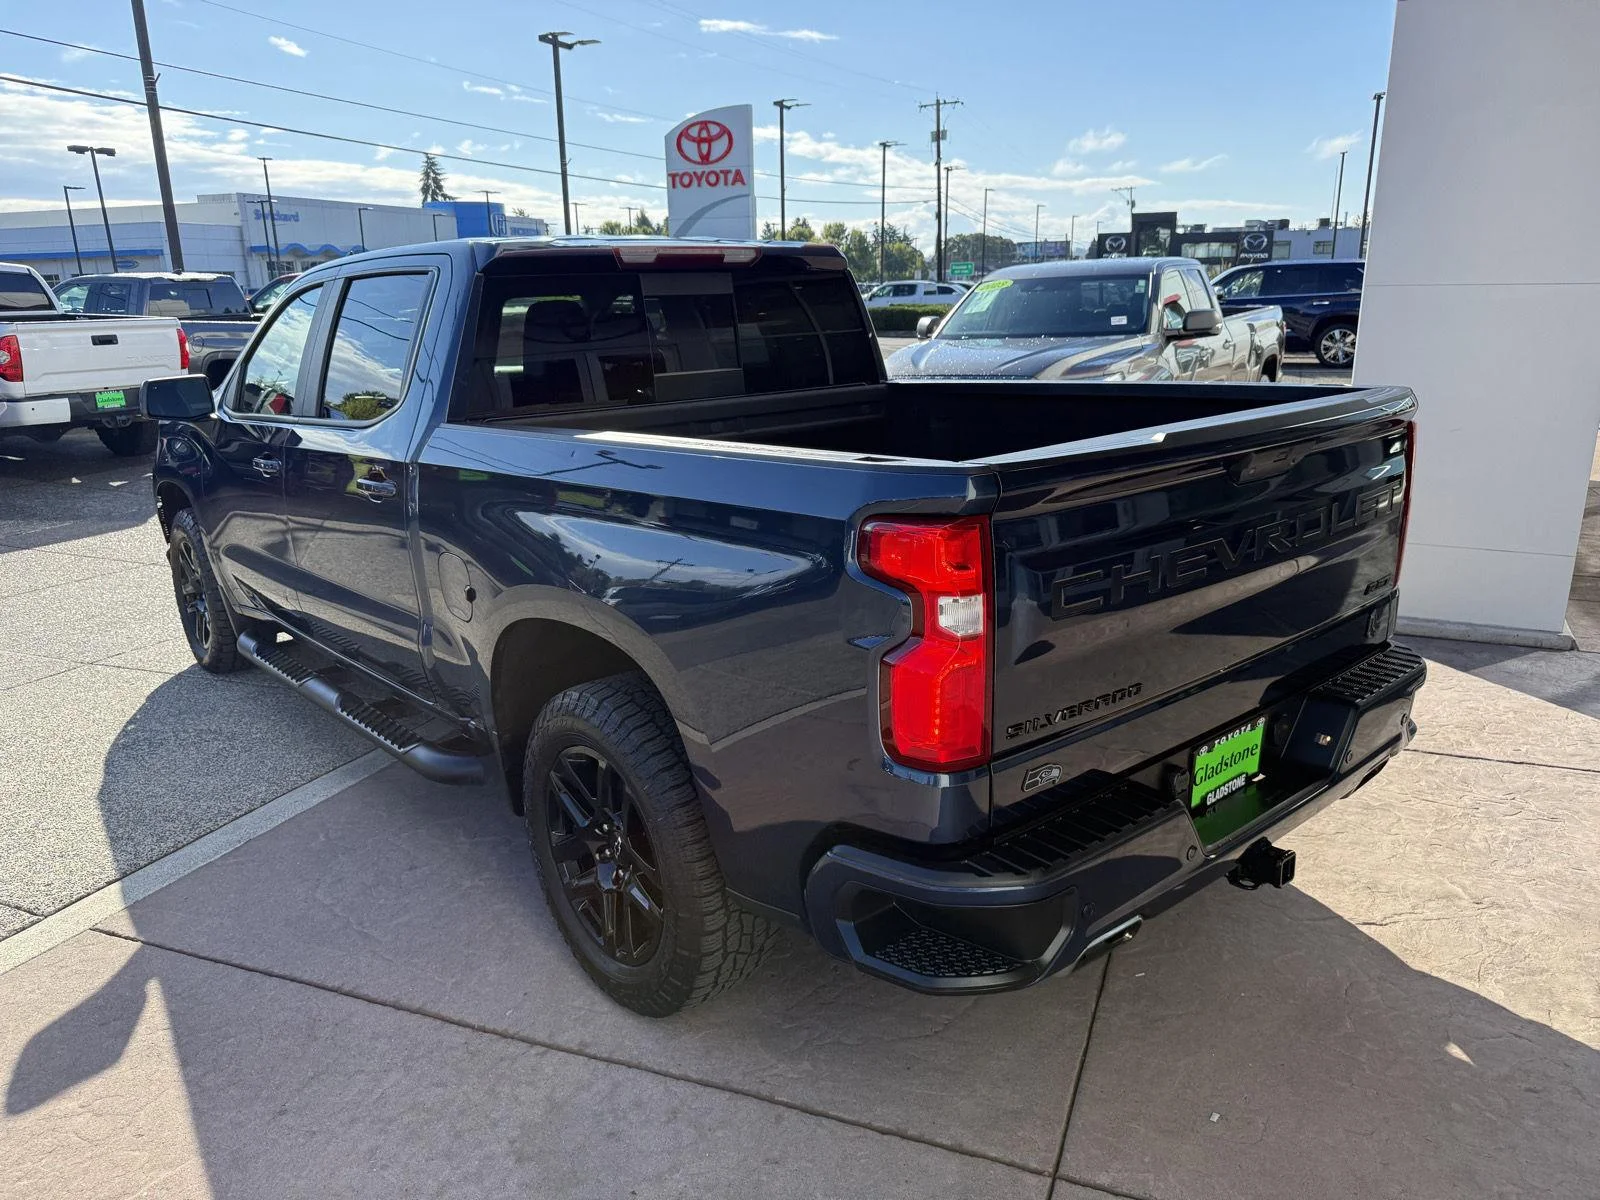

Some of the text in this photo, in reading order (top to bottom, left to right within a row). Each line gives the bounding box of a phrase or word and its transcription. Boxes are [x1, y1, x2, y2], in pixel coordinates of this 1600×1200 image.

[667, 169, 746, 189] TOYOTA
[1051, 479, 1403, 621] CHEVROLET
[1006, 682, 1143, 740] SILVERADO
[1214, 723, 1252, 748] TOYOTA
[1193, 743, 1258, 786] Gladstone
[1206, 773, 1247, 806] GLADSTONE
